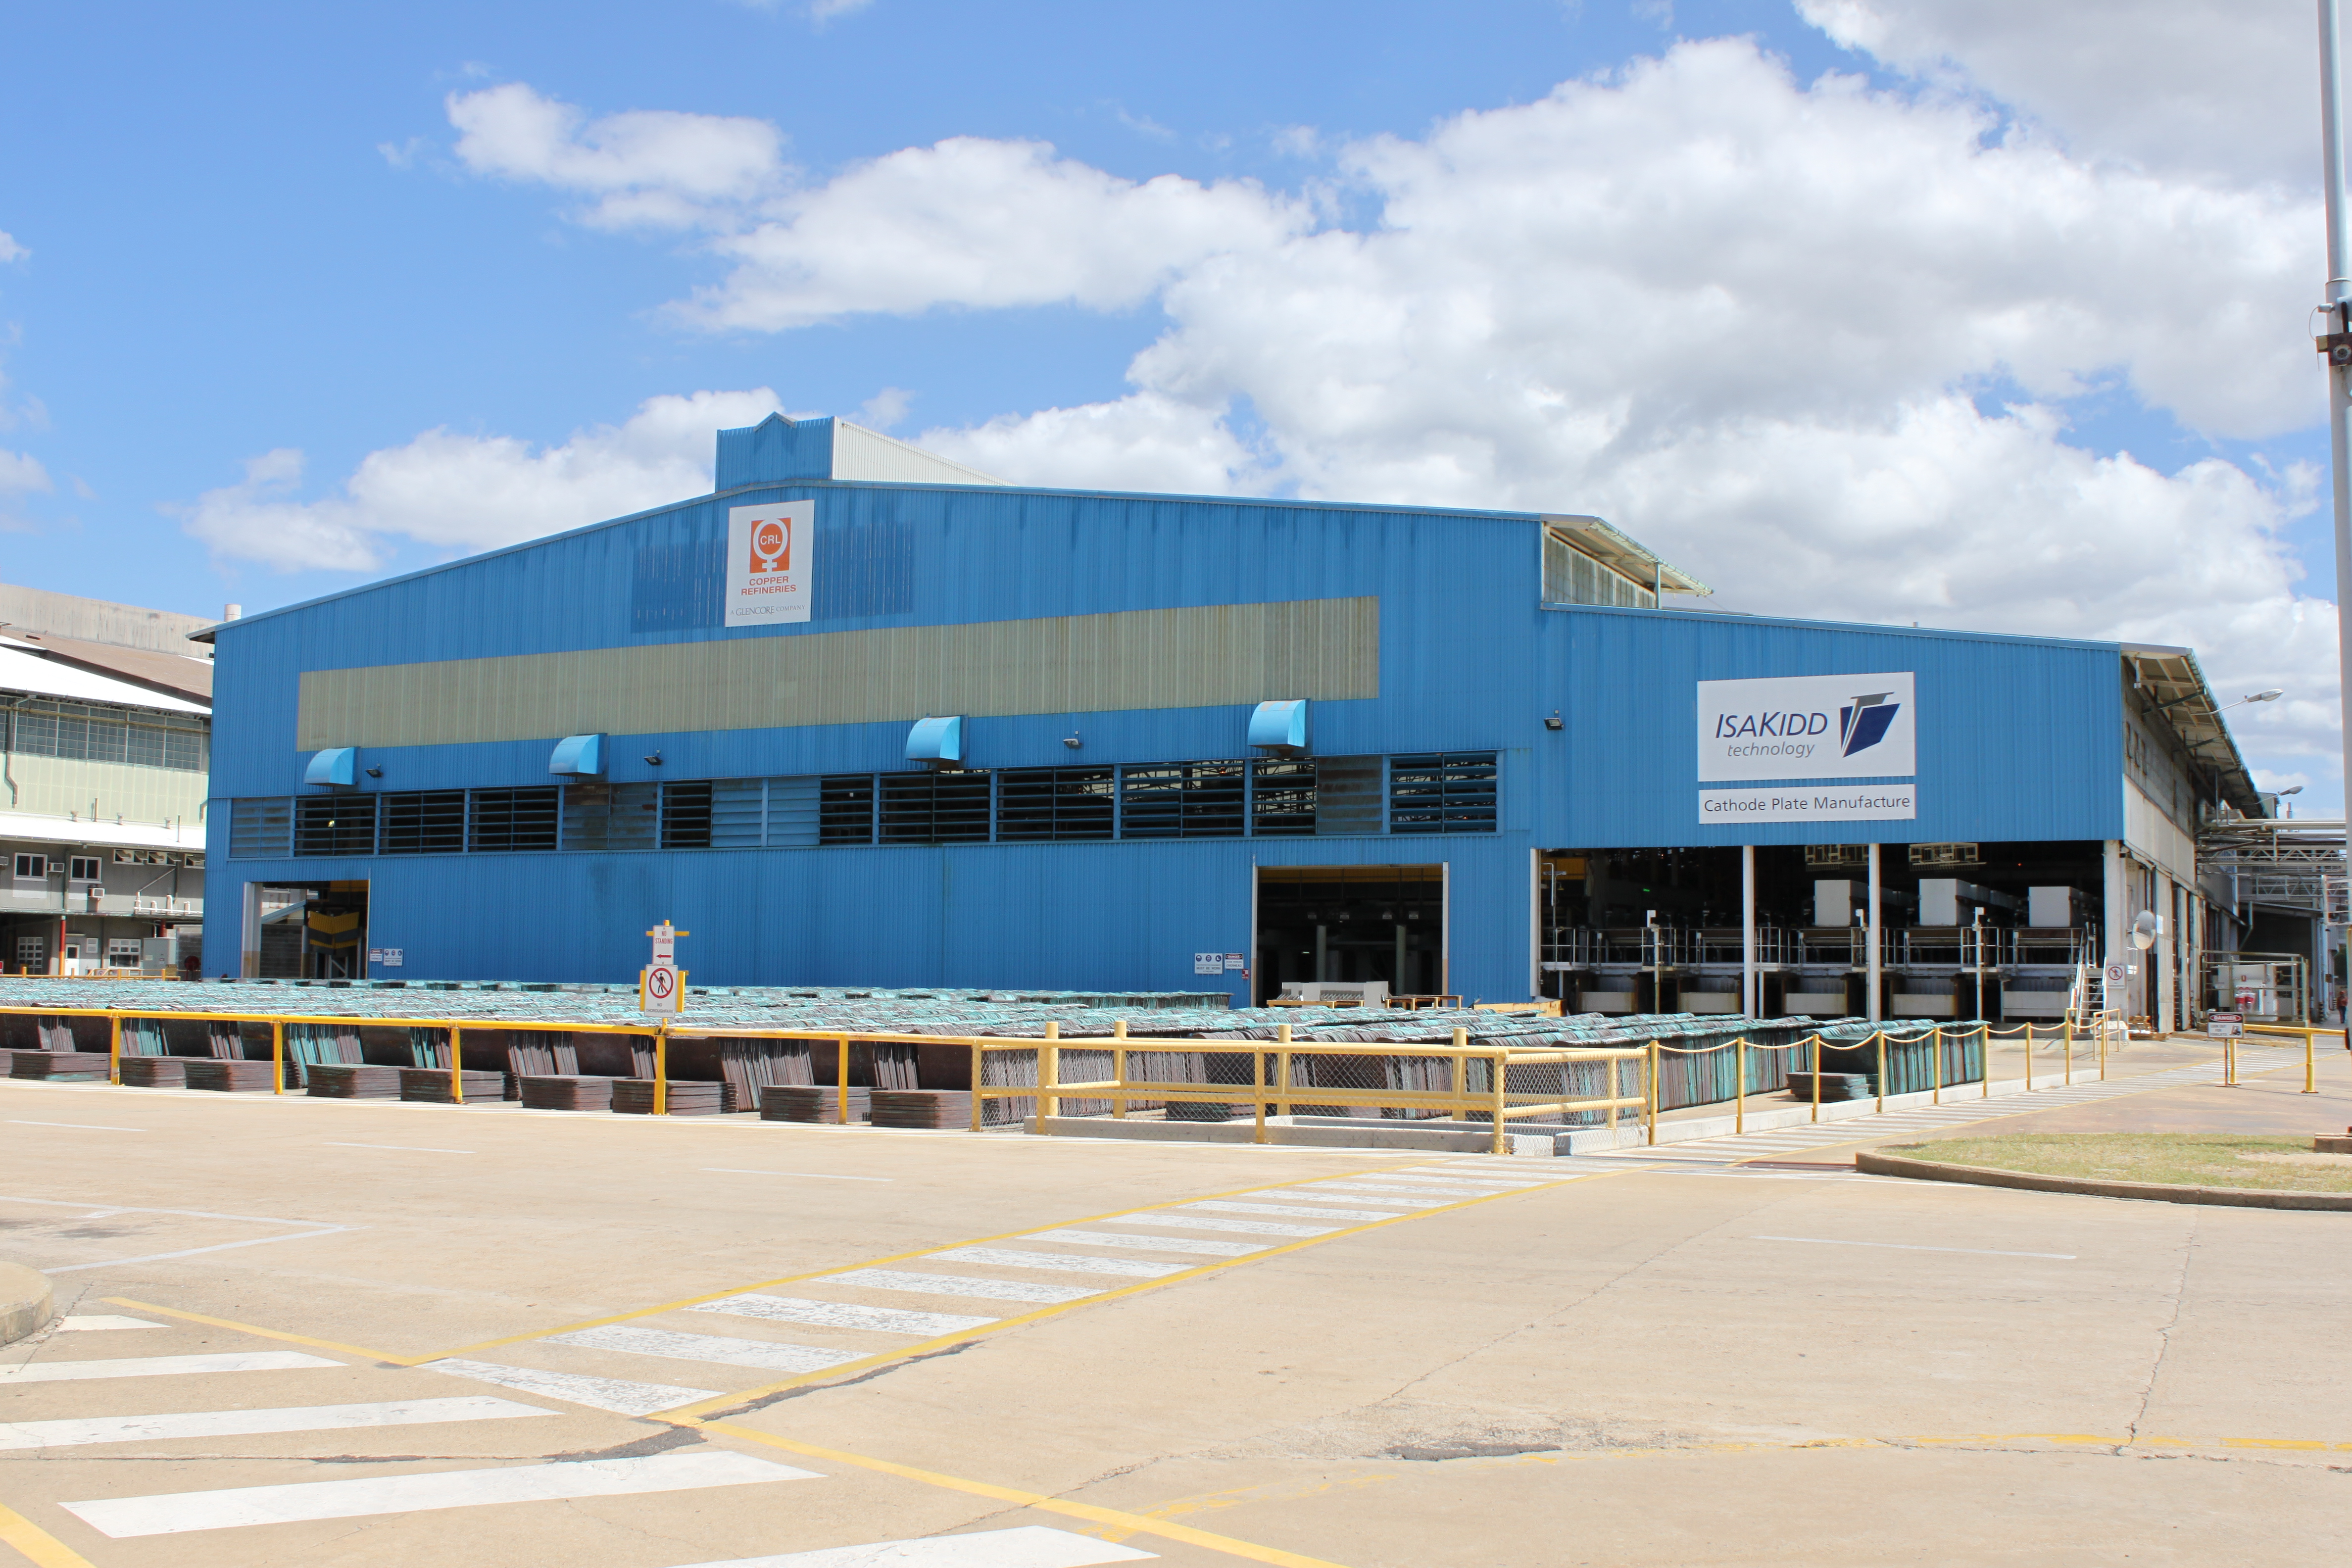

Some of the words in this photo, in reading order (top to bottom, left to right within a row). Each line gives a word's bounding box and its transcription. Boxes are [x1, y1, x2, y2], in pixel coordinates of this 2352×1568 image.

[760, 535, 781, 545] CRL
[749, 576, 789, 586] COPPER
[741, 585, 796, 595] REFINERIES
[736, 606, 775, 616] GLENCORE
[1715, 711, 1828, 738] ISAKIDD
[1727, 741, 1815, 758] technology
[1704, 798, 1765, 812] Cathode
[1771, 797, 1808, 810] Plate
[1814, 795, 1910, 810] Manufacture
